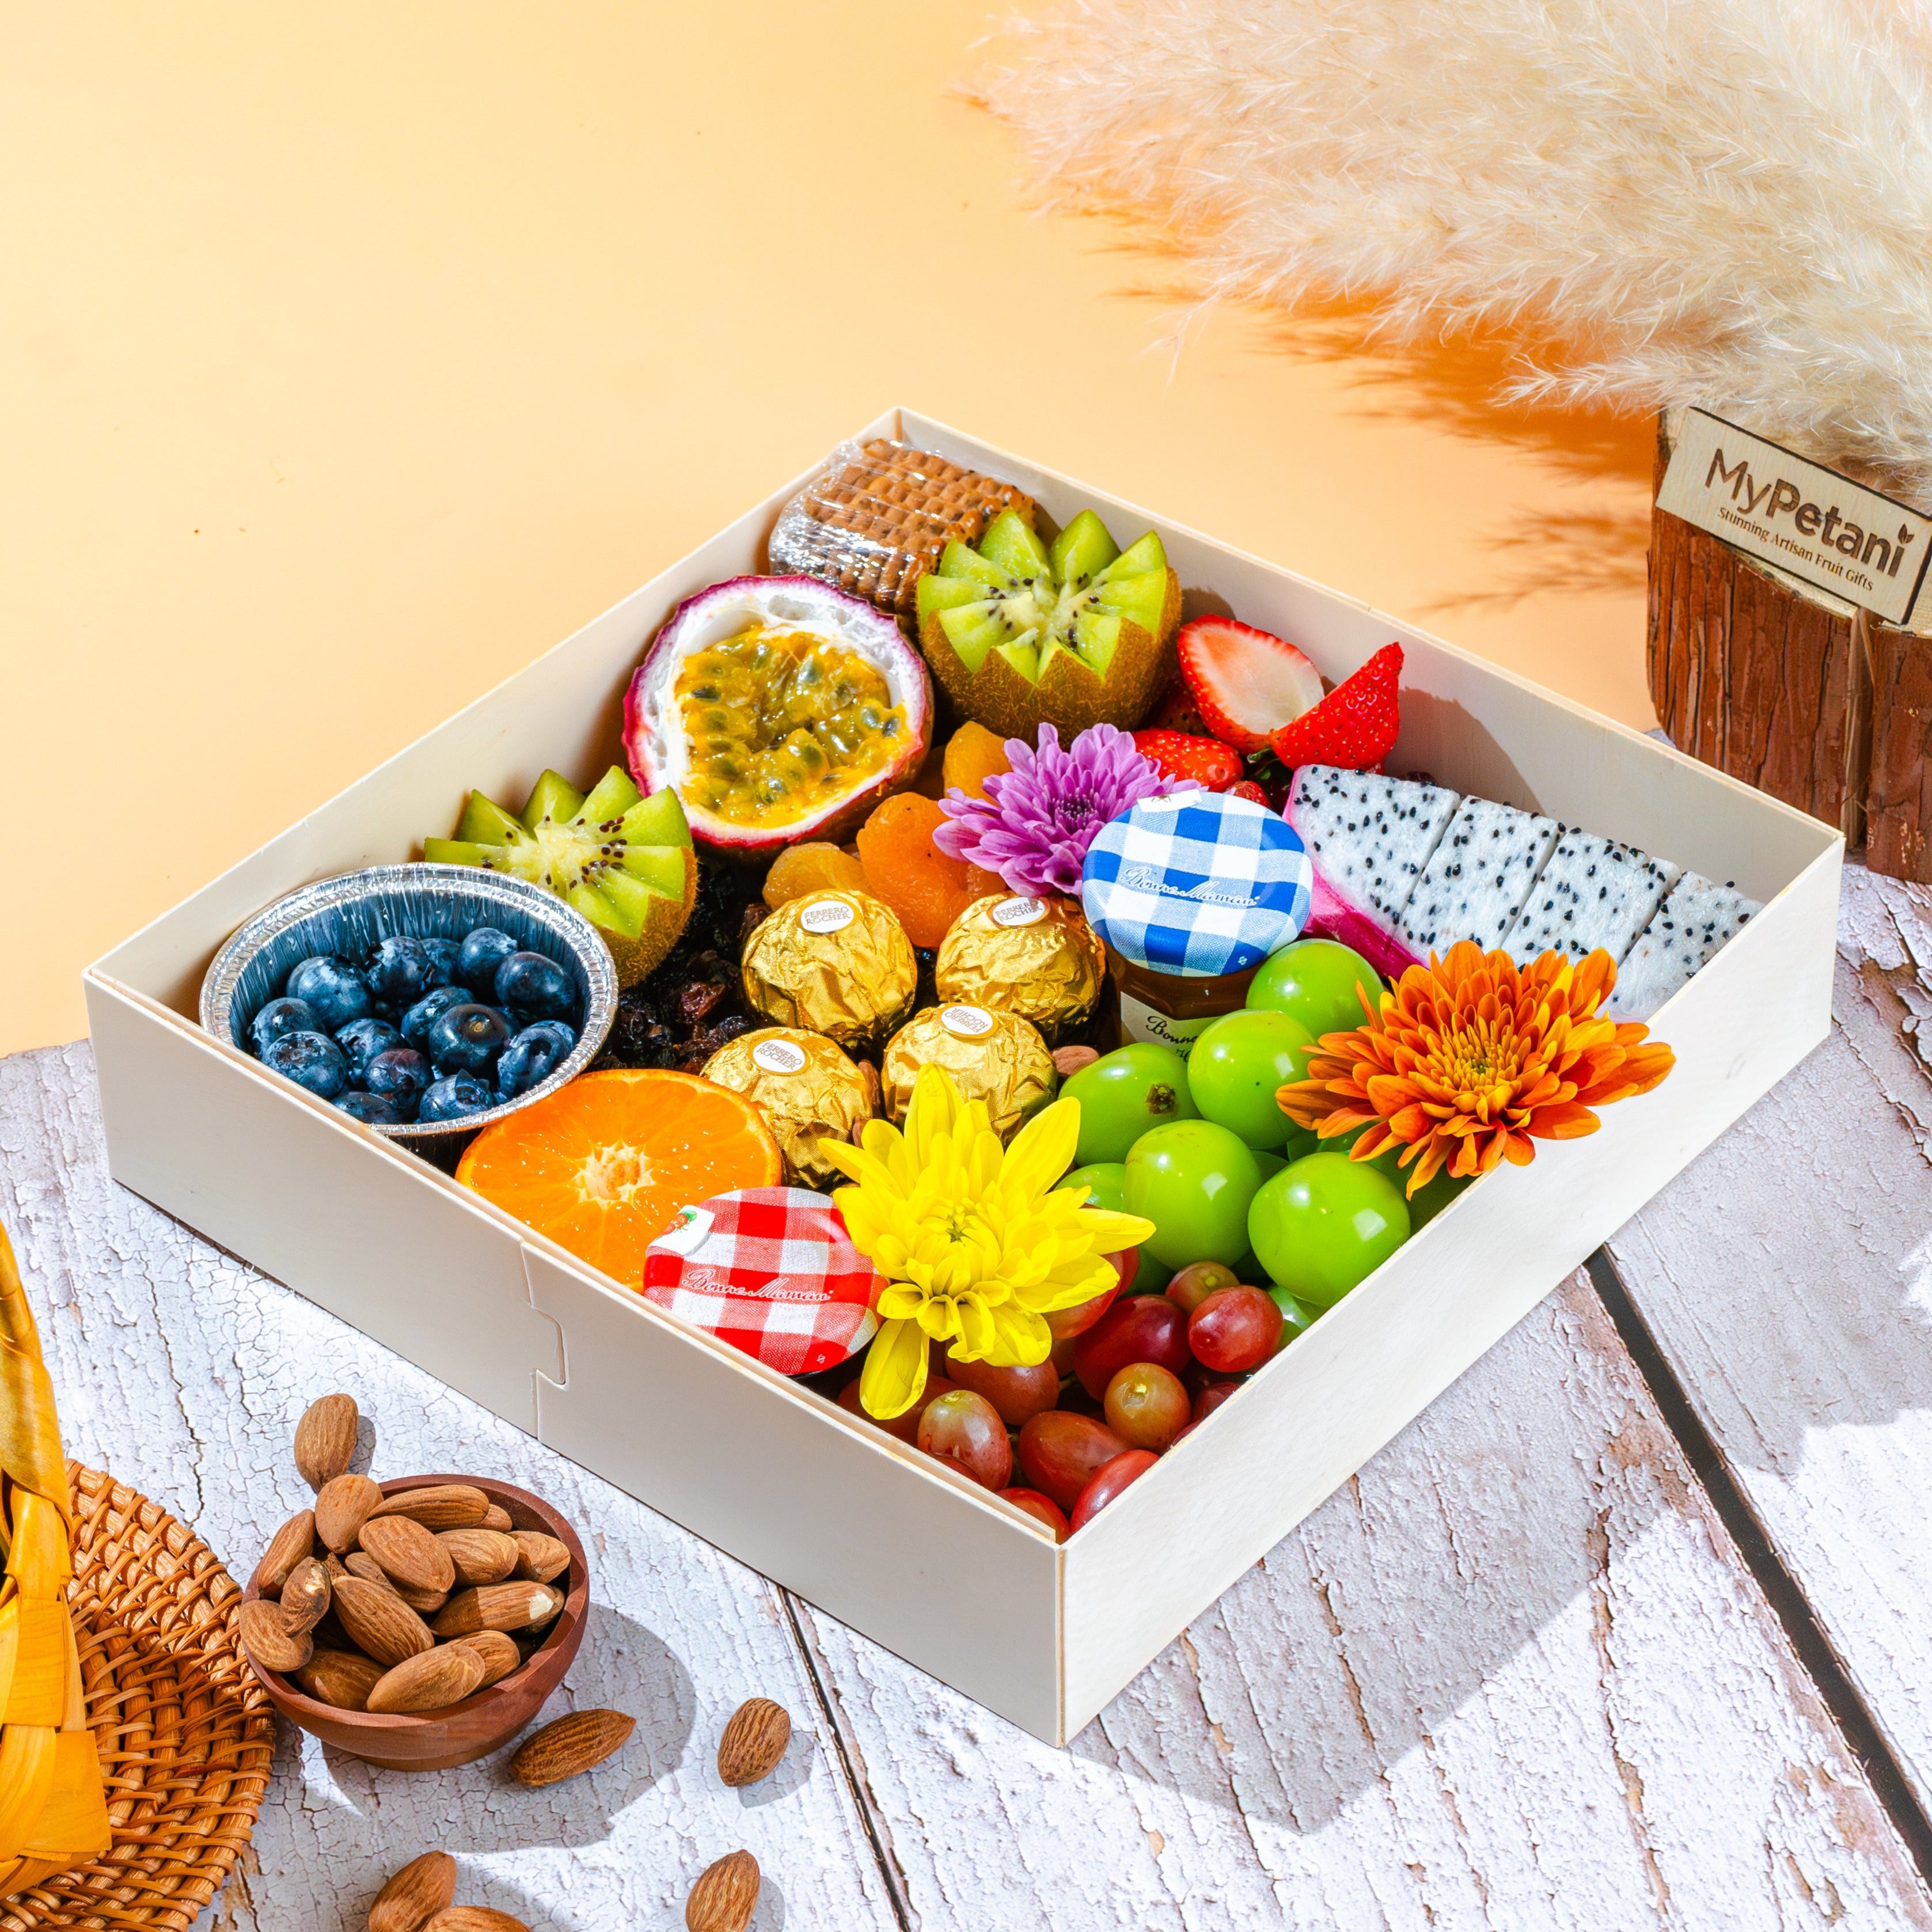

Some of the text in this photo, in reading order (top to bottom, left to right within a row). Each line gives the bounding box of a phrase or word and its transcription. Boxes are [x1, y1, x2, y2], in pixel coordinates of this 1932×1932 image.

[1705, 448, 1913, 579] MyPetani
[1718, 507, 1874, 591] Stunning Artisan Fruit Gifts
[1120, 866, 1258, 906] Bonne Maman
[804, 906, 849, 918] FERRERO
[806, 913, 851, 925] ROCHER
[995, 899, 1039, 916] FERRERO
[944, 1012, 982, 1033] FERRERO
[952, 1008, 988, 1028] ROCHER
[756, 1047, 796, 1071] ROCHER
[761, 1042, 802, 1065] FERRERO
[682, 1268, 832, 1301] Bonne Maman
